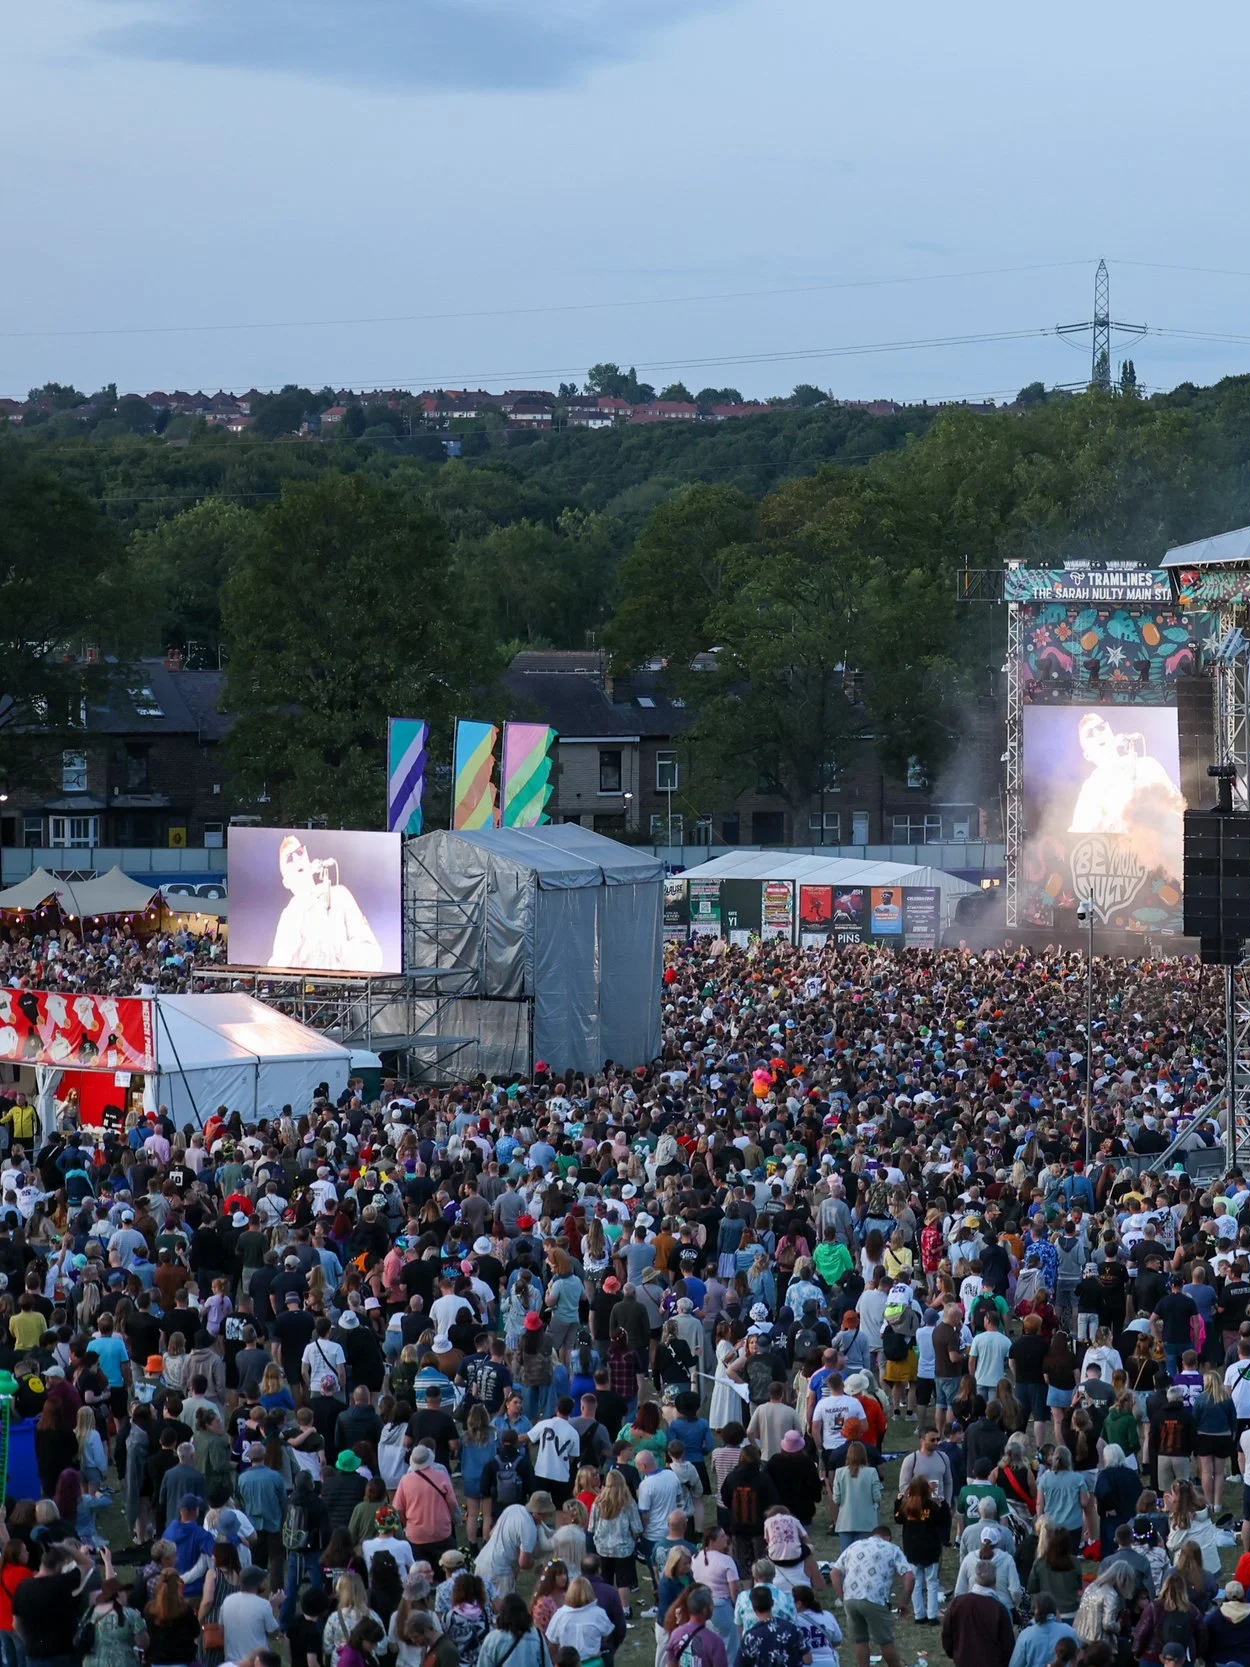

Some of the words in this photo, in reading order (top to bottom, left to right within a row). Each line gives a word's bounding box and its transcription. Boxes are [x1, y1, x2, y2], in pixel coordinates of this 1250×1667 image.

[1088, 573, 1153, 586] TRAMLINES
[1033, 587, 1053, 600] THE
[1055, 587, 1090, 600] SARAH
[1092, 588, 1124, 601] NULTY
[1126, 588, 1152, 600] MAIN
[1075, 841, 1107, 875] BE
[838, 934, 861, 943] PINS
